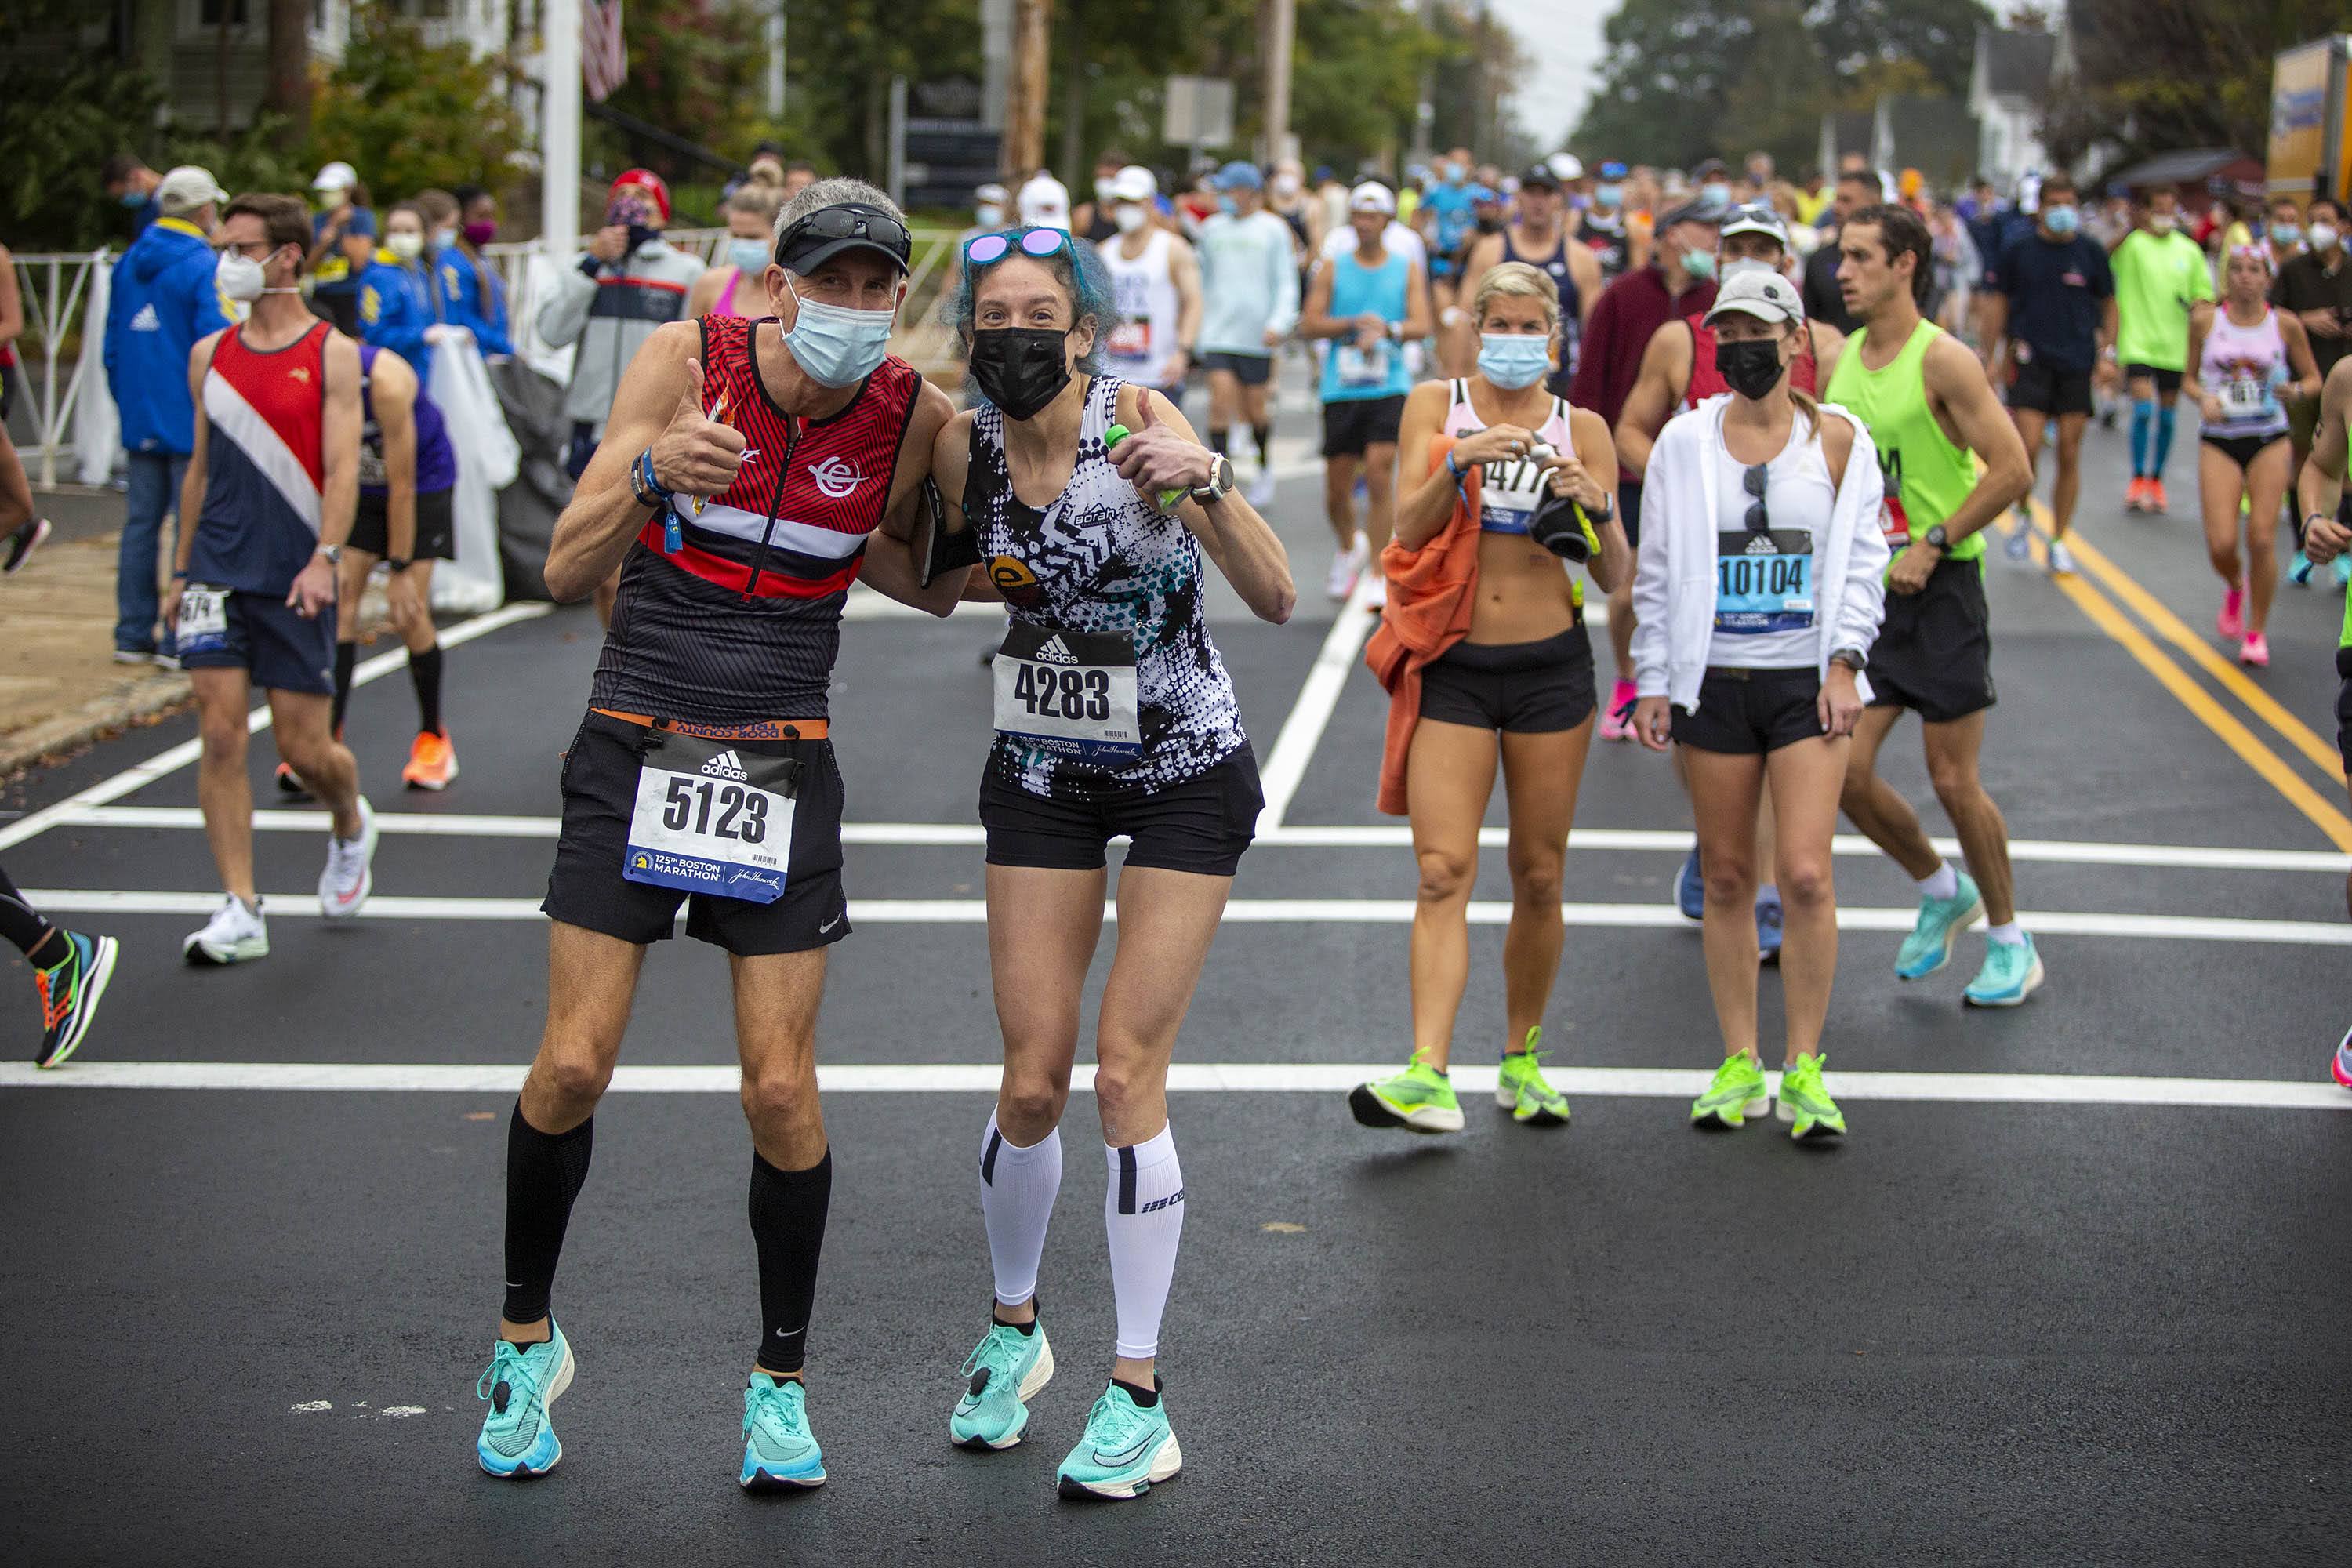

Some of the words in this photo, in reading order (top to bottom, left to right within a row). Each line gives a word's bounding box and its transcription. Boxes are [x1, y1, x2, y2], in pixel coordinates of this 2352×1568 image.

[1719, 559, 1803, 595] 10104
[1036, 650, 1079, 665] adidas
[1014, 663, 1110, 721] 4283
[677, 724, 733, 738] COUNTY
[738, 729, 779, 739] DOOR
[1041, 739, 1080, 749] BOSTON
[701, 763, 748, 781] adidas
[663, 776, 769, 844] 5123
[655, 854, 678, 864] 125TH
[679, 859, 720, 873] BOSTON
[654, 864, 720, 882] MARATHON
[728, 869, 750, 884] John
